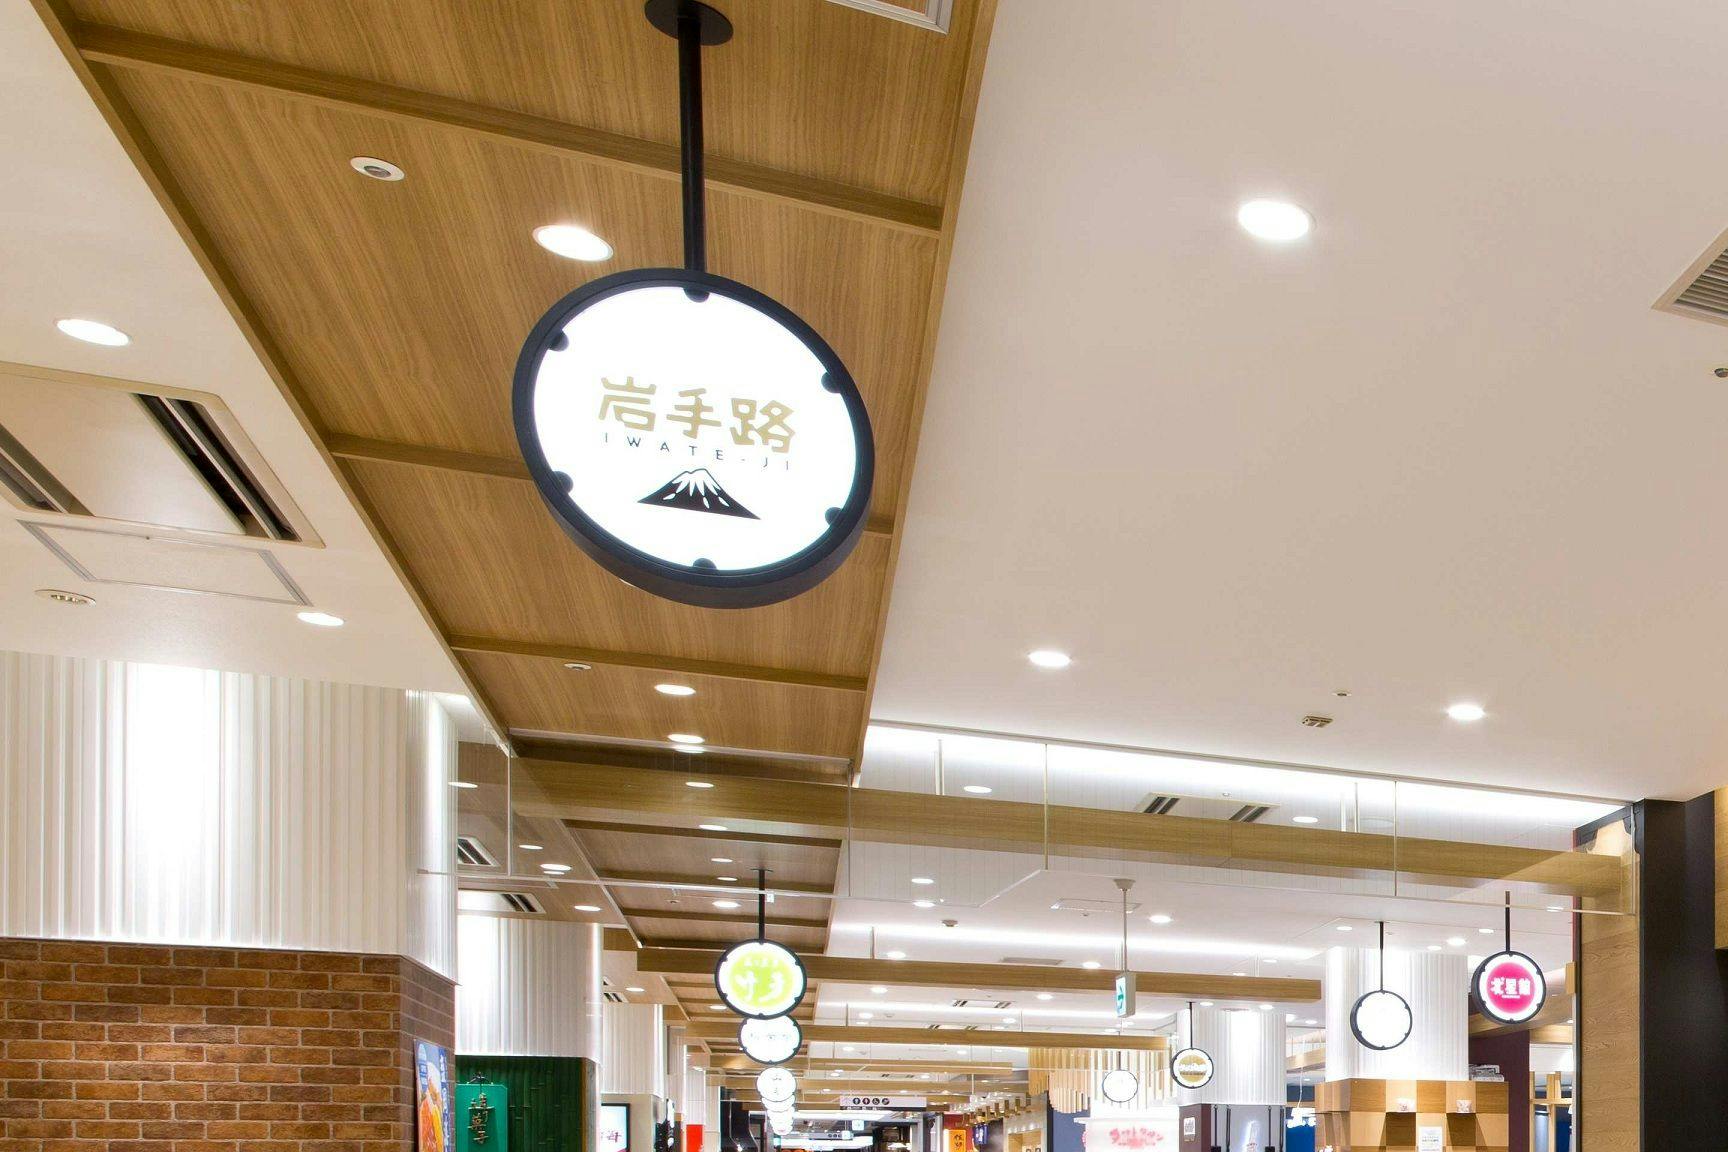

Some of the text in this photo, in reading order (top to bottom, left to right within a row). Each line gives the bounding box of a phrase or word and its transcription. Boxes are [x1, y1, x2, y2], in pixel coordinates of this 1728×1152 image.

[598, 376, 796, 454] 岩手路
[604, 432, 790, 471] IWATE-JI
